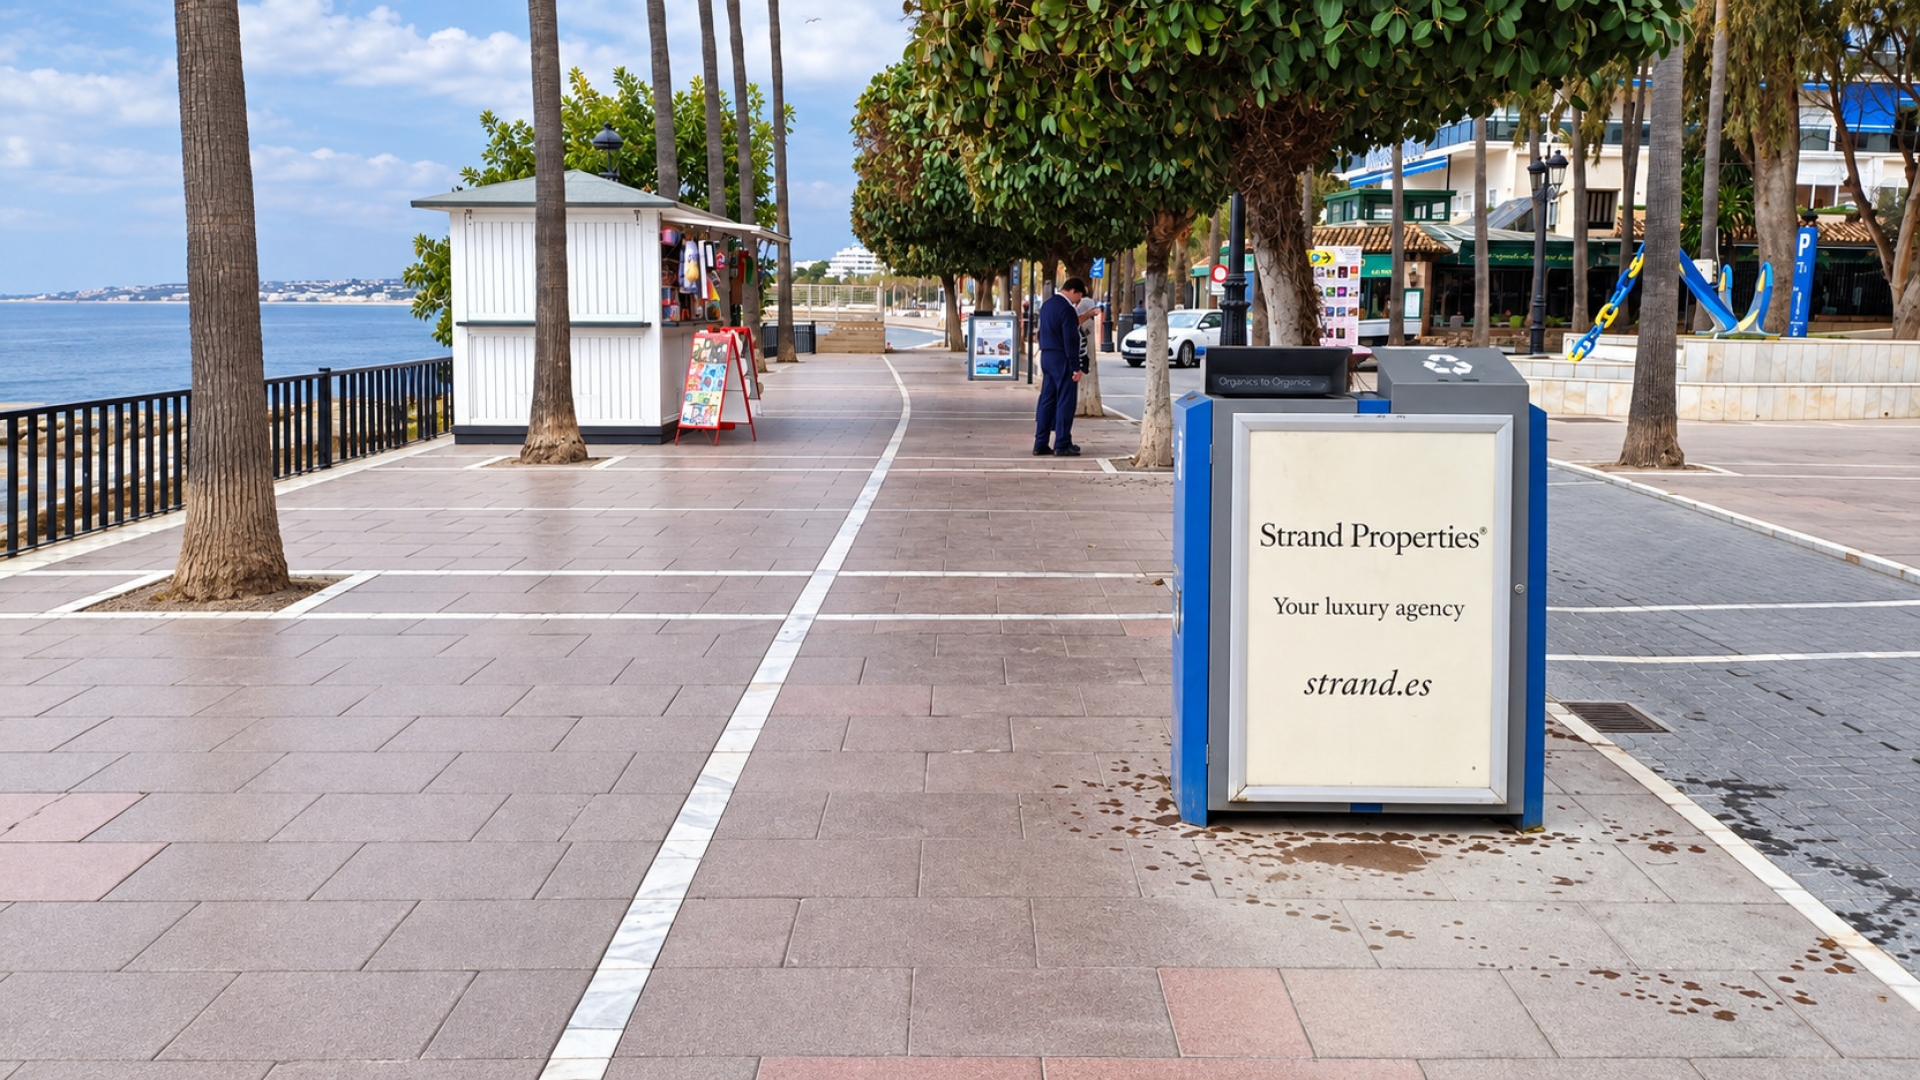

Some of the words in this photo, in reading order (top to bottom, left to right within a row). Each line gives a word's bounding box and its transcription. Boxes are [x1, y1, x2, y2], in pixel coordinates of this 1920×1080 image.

[1798, 233, 1811, 257] P
[1260, 378, 1270, 387] to
[1260, 522, 1344, 548] Strand
[1273, 596, 1320, 616] Your
[1325, 596, 1390, 622] luxury
[1395, 602, 1466, 623] agency
[1303, 669, 1433, 697] strand.es
